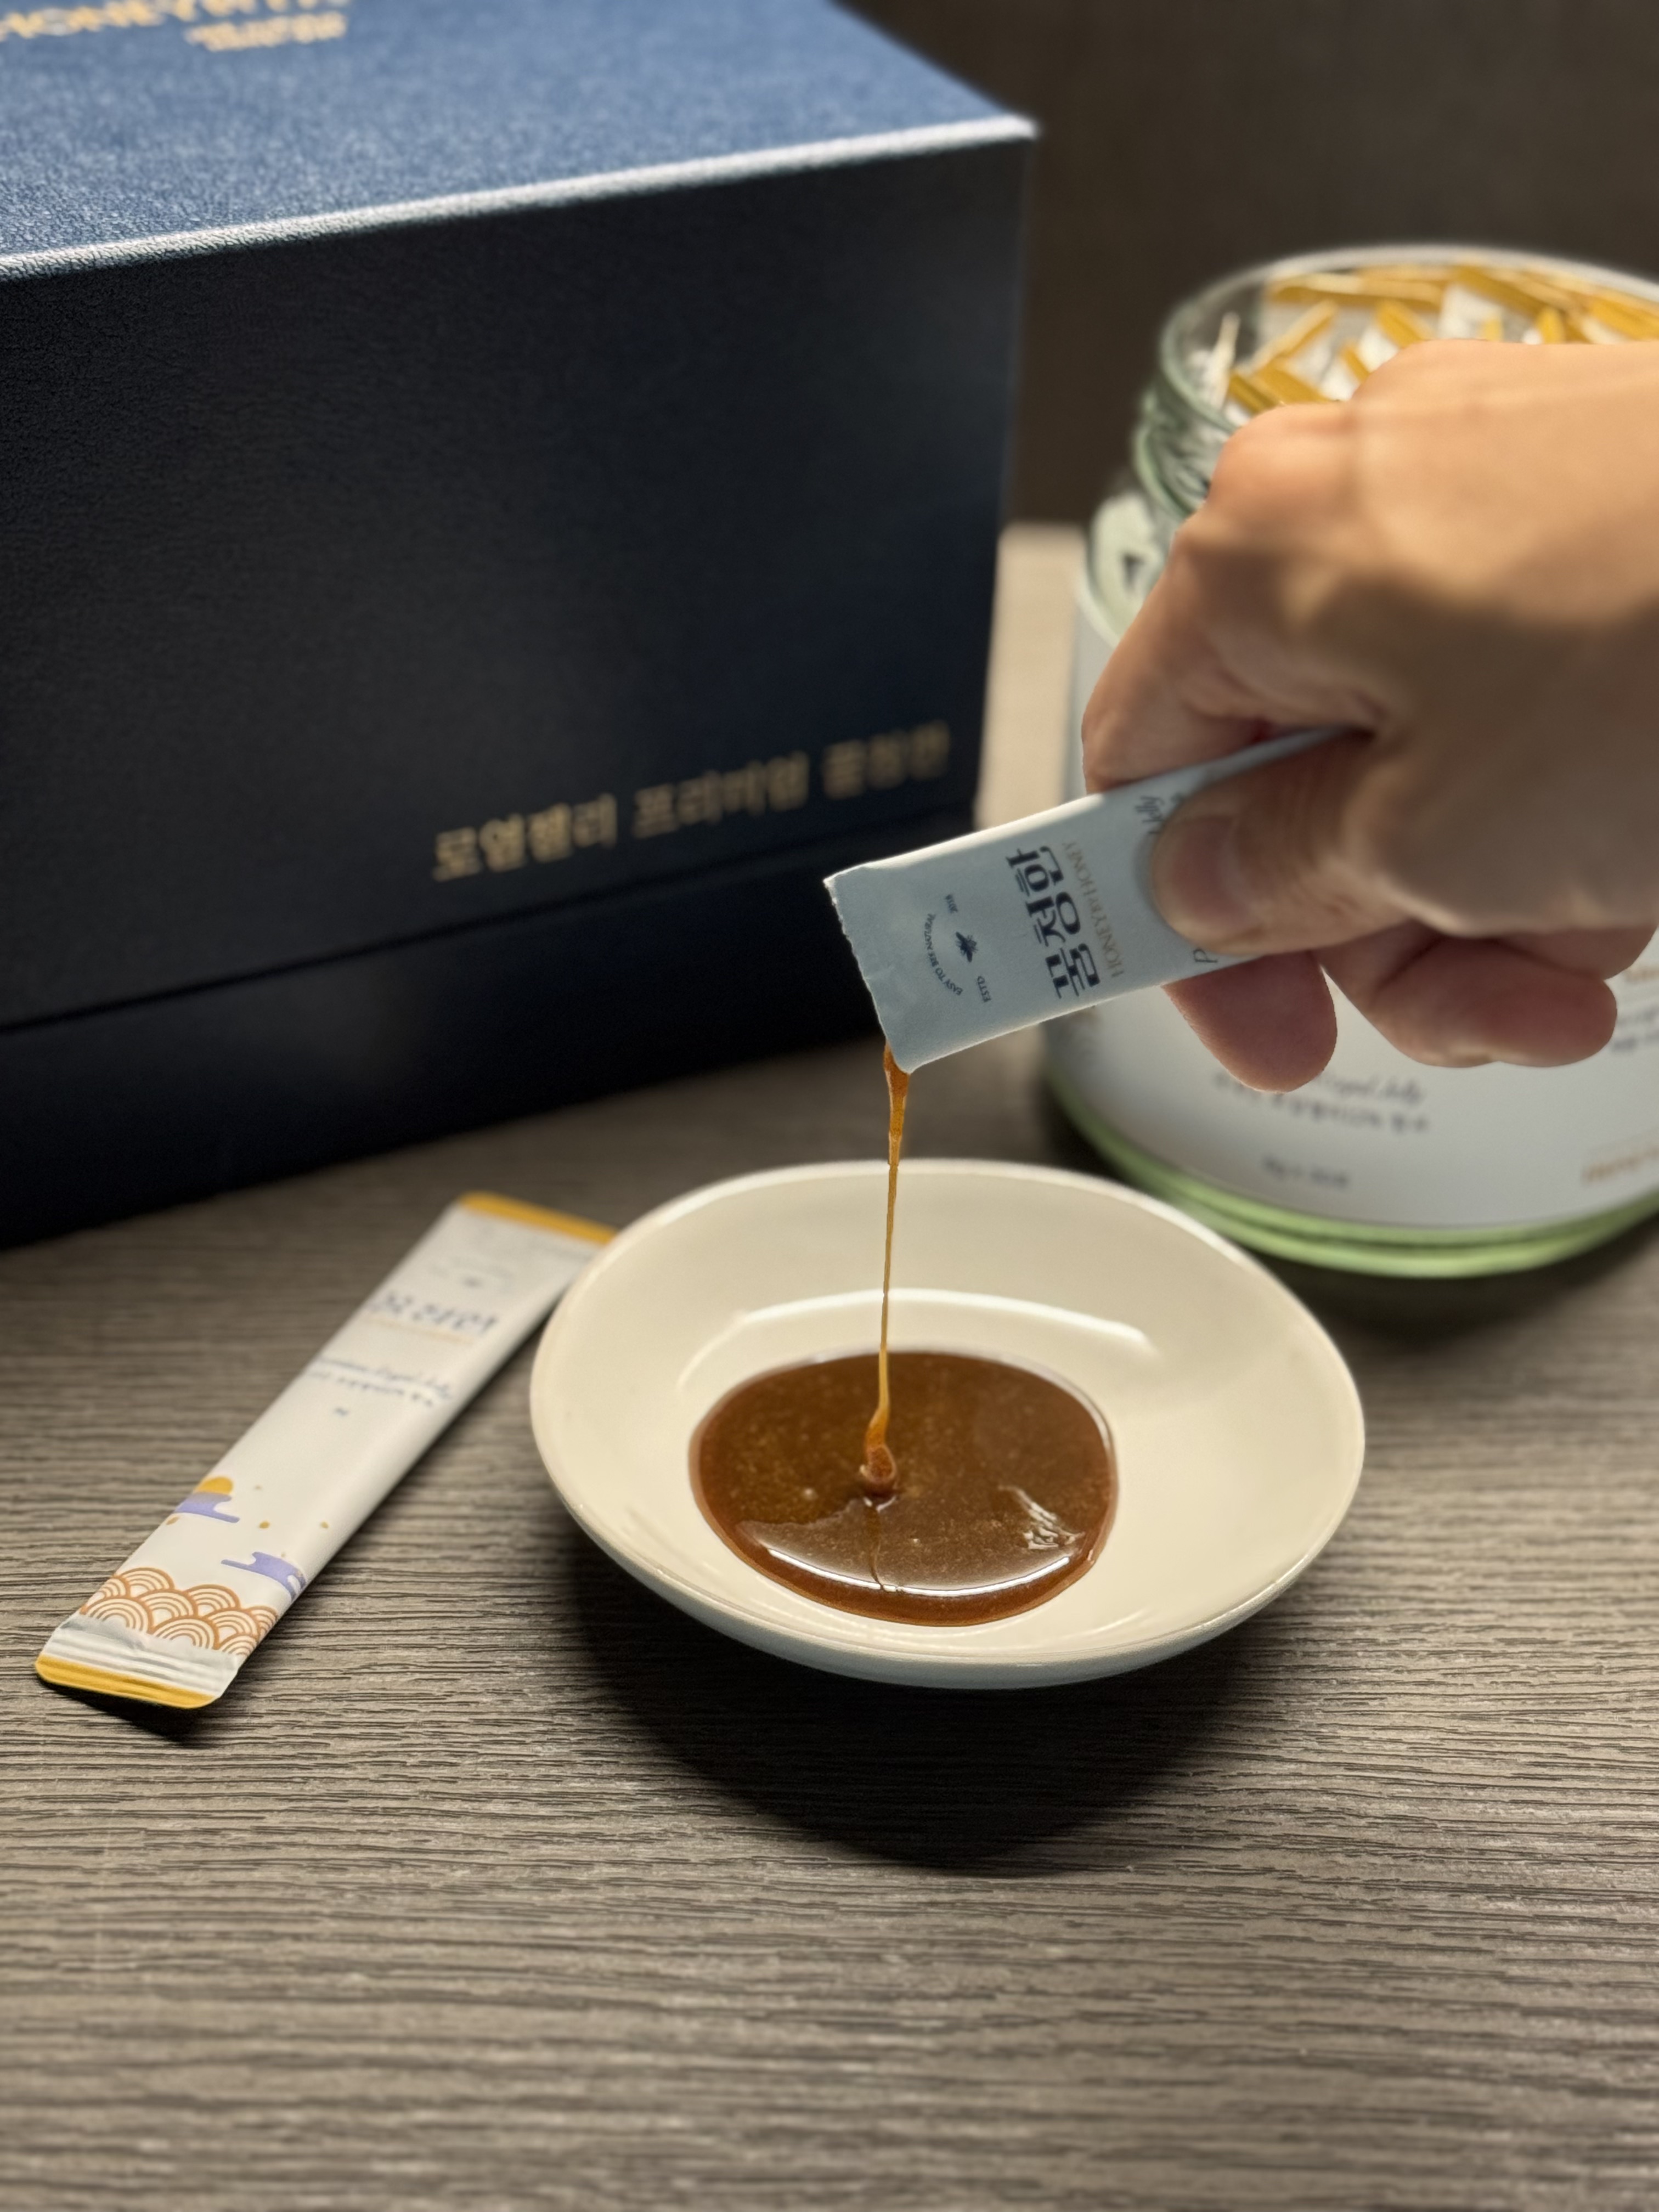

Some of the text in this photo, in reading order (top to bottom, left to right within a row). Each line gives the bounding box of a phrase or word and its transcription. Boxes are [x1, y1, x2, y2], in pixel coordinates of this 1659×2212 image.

[924, 913, 936, 950] NATURAL
[1006, 845, 1101, 999] 꿀청한
[935, 968, 946, 981] TO
[944, 979, 963, 996] EASY
[977, 975, 991, 1002] ESTD
